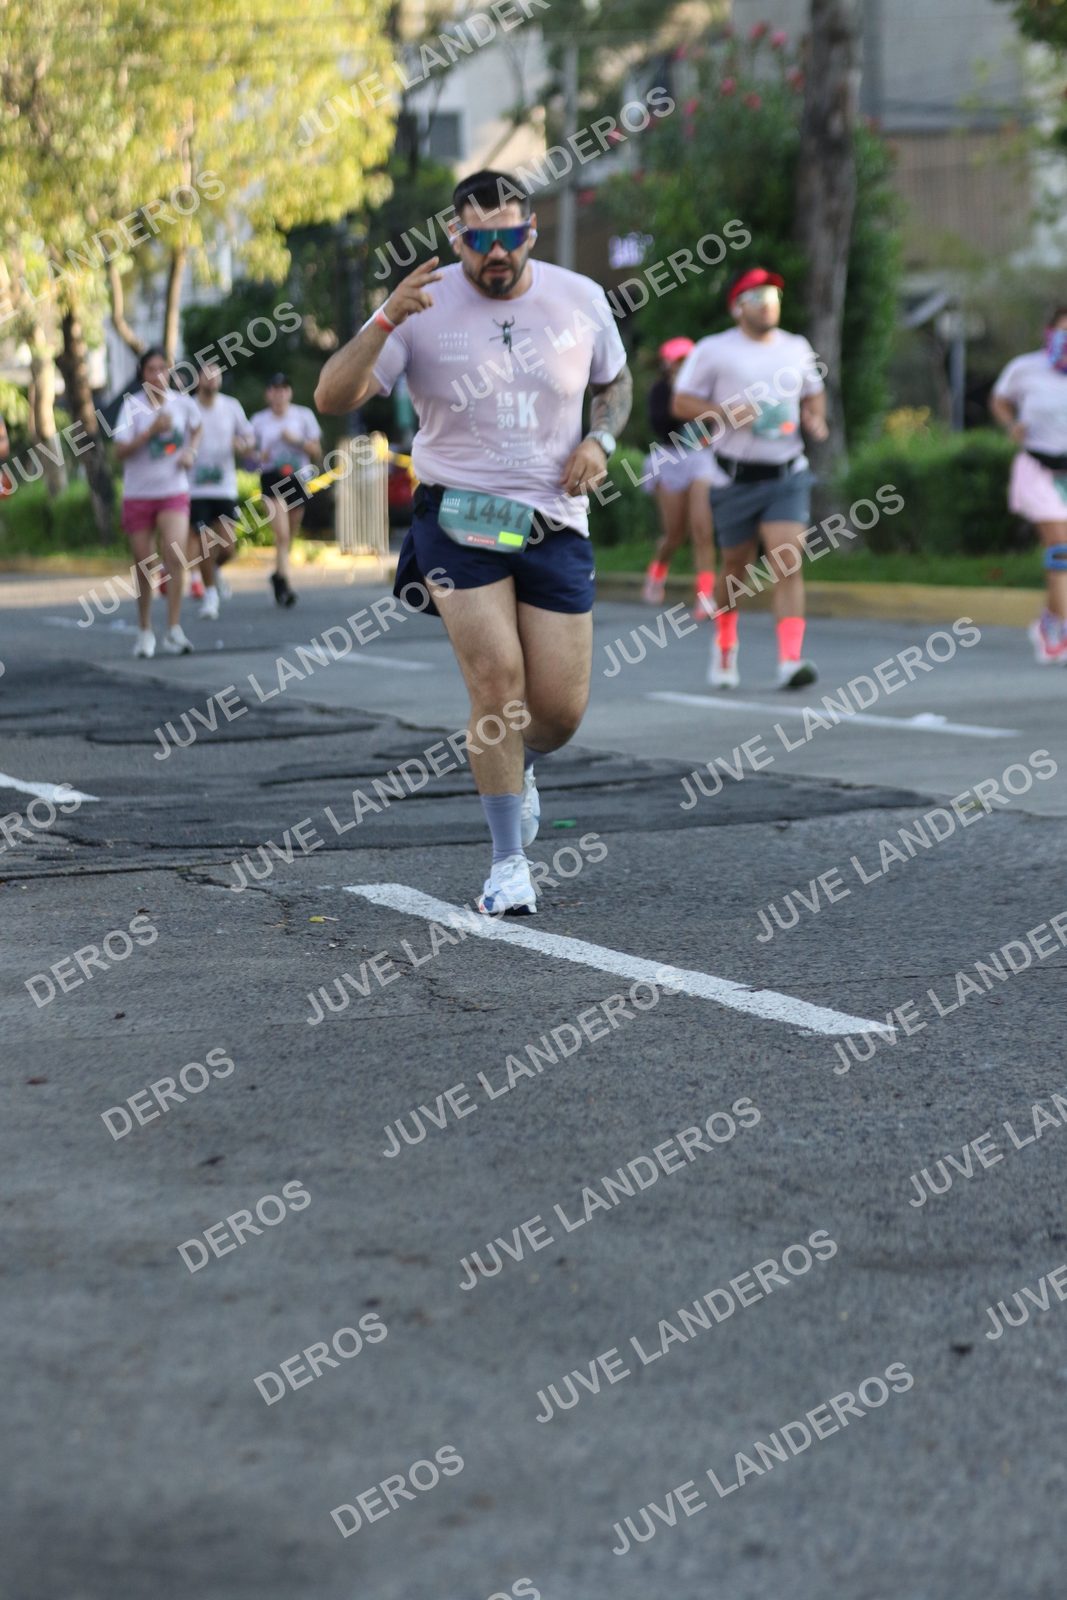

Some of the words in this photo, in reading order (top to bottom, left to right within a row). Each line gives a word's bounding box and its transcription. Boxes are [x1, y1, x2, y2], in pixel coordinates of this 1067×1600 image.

[497, 412, 515, 429] 30
[518, 391, 540, 430] K
[464, 494, 528, 529] 1447
